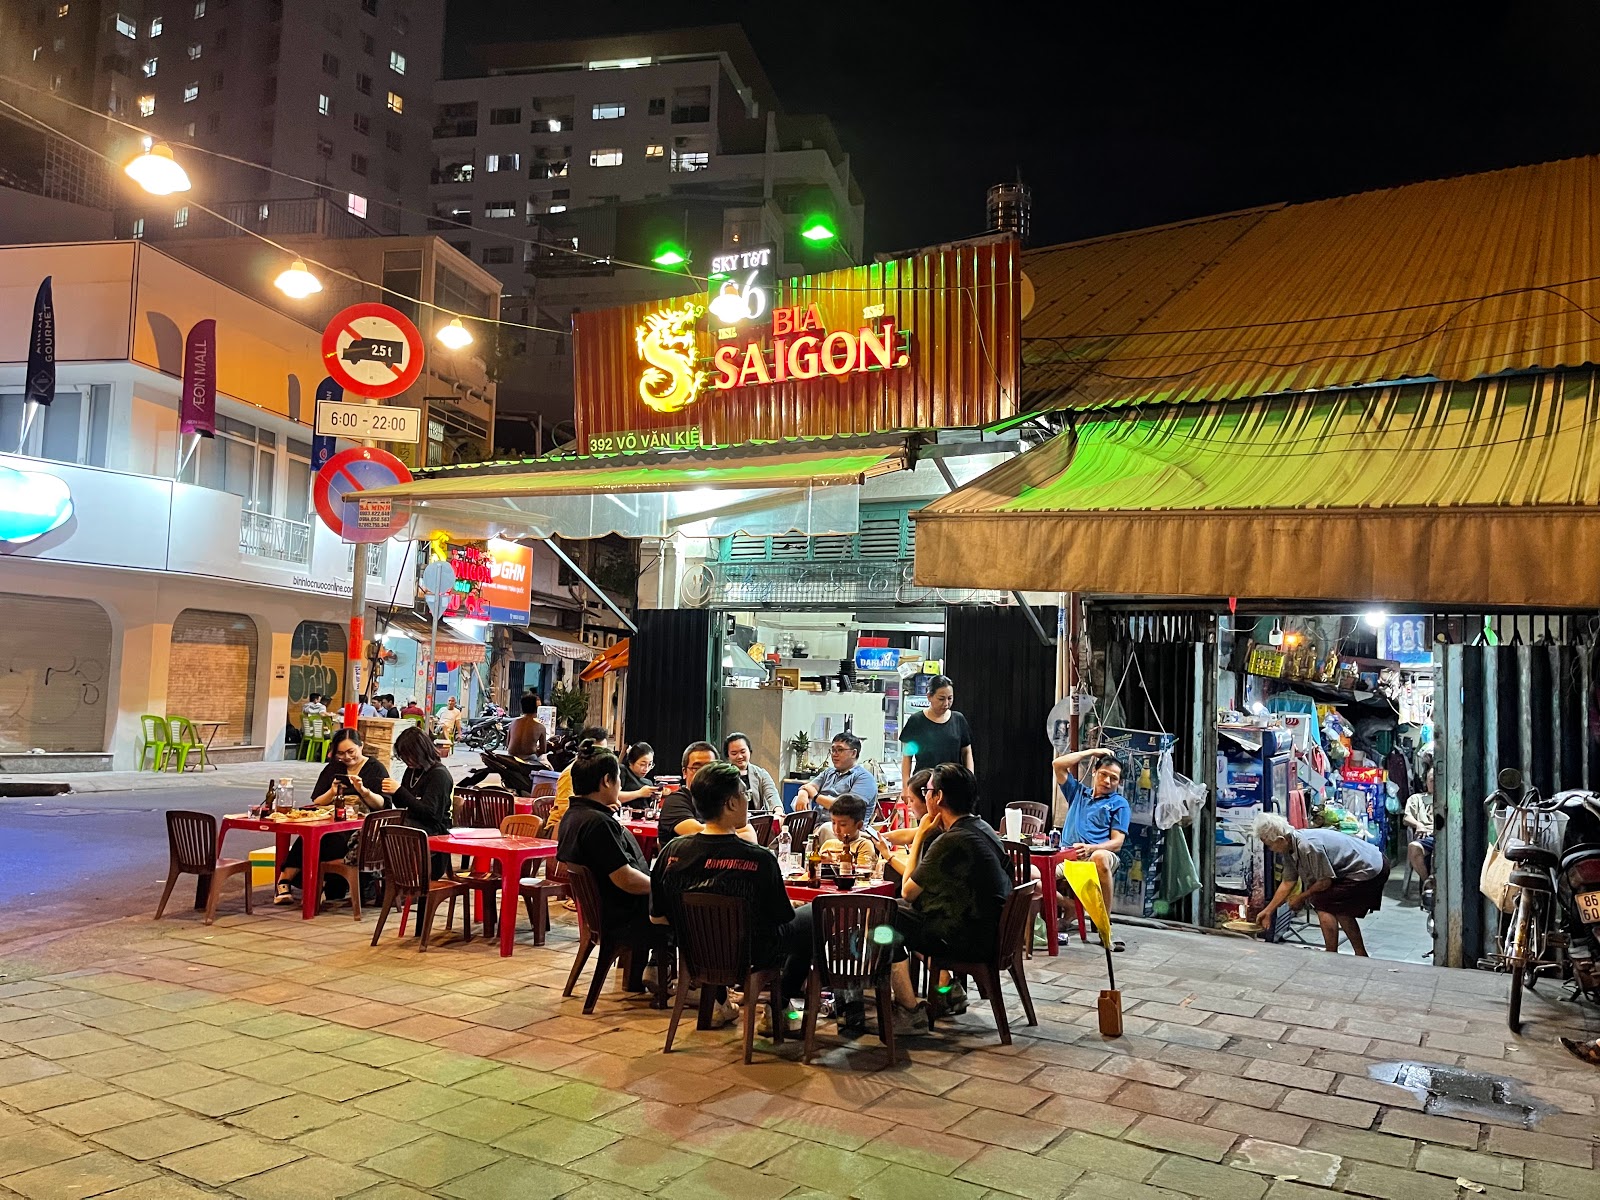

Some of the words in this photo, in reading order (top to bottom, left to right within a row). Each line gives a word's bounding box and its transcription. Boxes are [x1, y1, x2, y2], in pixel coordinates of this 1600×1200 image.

[712, 254, 739, 273] SKY
[740, 249, 770, 268] T&T
[772, 302, 825, 336] BIA
[44, 304, 53, 362] GOURMET
[194, 339, 207, 375] MALL
[331, 411, 358, 427] 6:00
[372, 415, 406, 431] 22:00
[590, 438, 613, 452] 392
[616, 432, 637, 450] VÕ
[641, 430, 670, 448] VĂN
[501, 561, 526, 582] GHN
[860, 659, 896, 667] DARLING
[1584, 895, 1598, 907] 86
